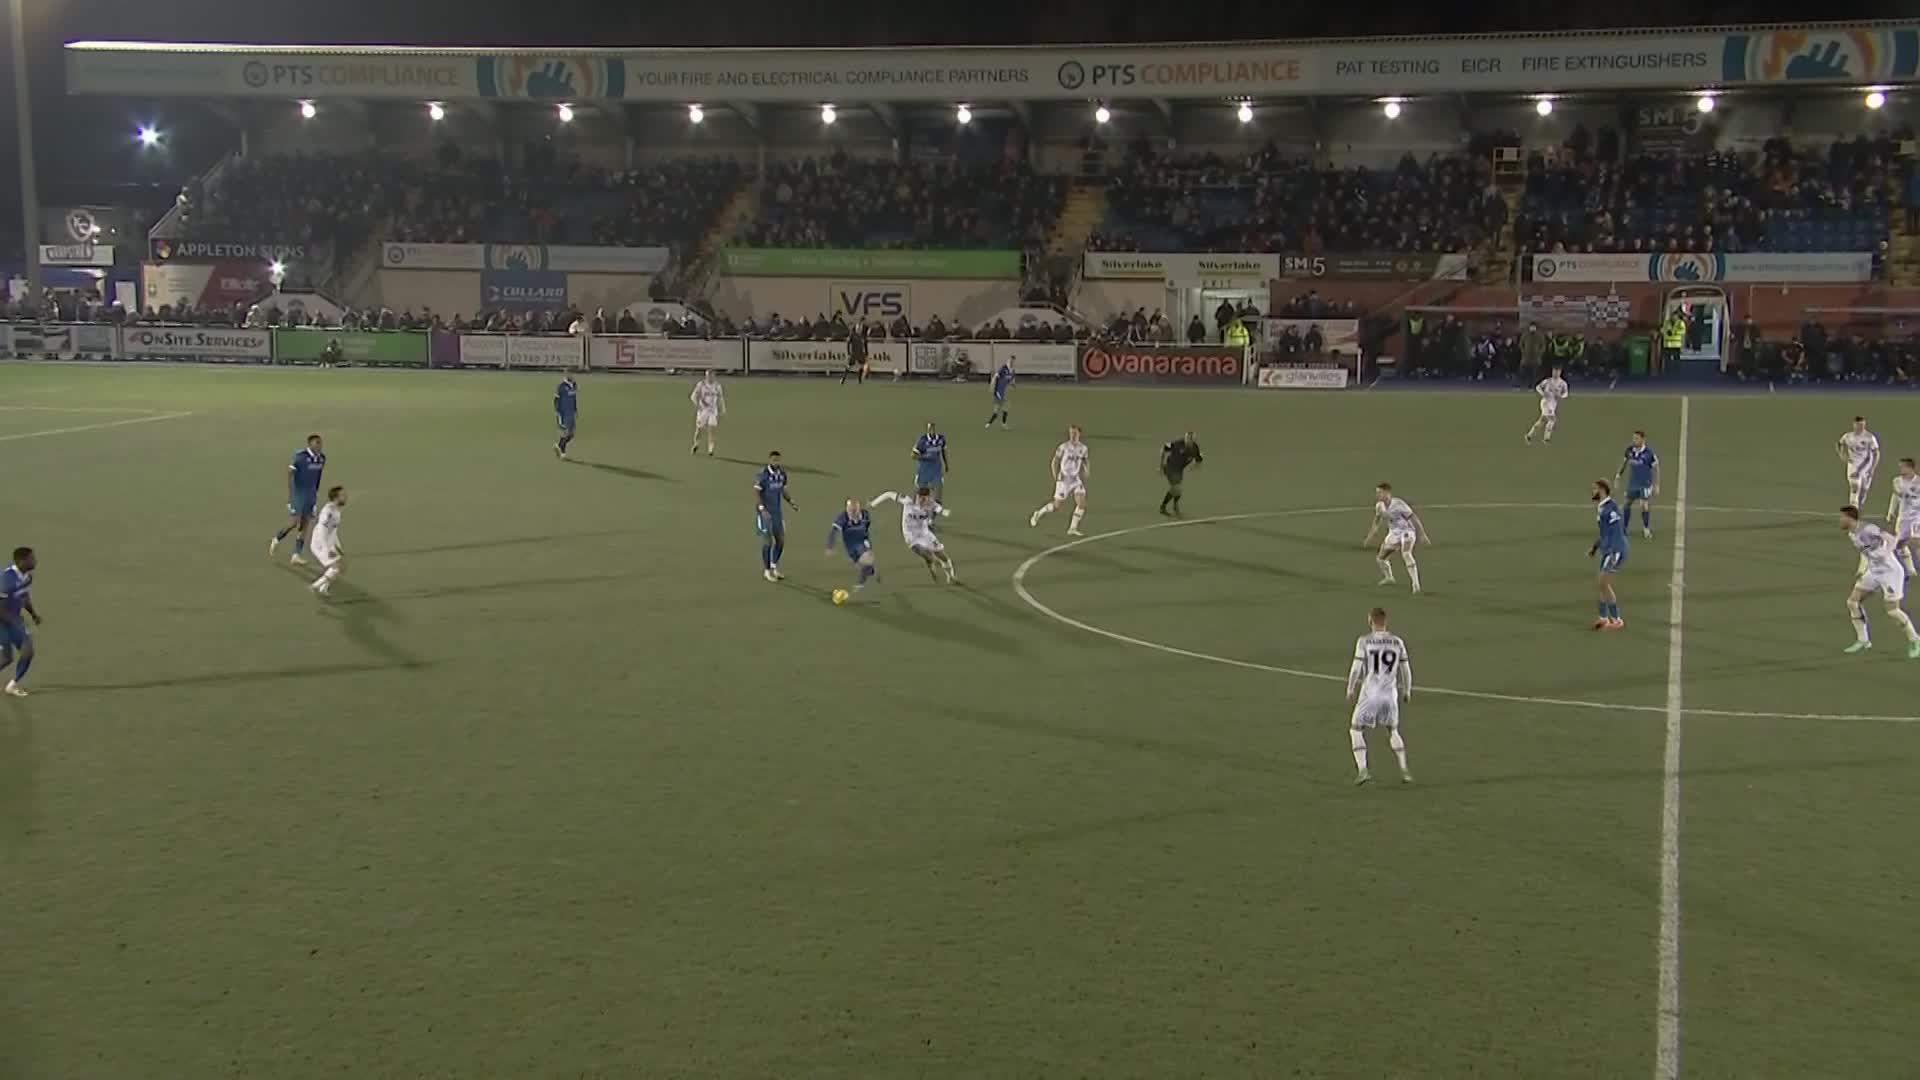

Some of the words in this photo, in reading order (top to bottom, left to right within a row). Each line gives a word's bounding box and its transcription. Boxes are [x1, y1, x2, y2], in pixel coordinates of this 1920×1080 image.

[1093, 64, 1135, 85] PTS
[1141, 60, 1300, 84] COMPLIANCE
[1336, 60, 1365, 75] PAT
[1371, 59, 1440, 74] TESTING
[1461, 58, 1501, 73] EICR
[1522, 56, 1560, 71] FIRE
[1565, 53, 1707, 71] EXTINGUISHERS
[273, 65, 313, 84] PTS
[319, 66, 459, 86] COMPLIANCE
[638, 72, 678, 86] YOUR
[681, 72, 713, 86] FIRE
[718, 72, 748, 86] AND
[751, 71, 842, 86] ELECTRICAL
[846, 70, 945, 85] COMPLIANCE
[949, 68, 1029, 83] PARTNERS
[176, 243, 256, 257] APPLETON
[260, 245, 304, 258] SIGNS
[840, 292, 902, 316] VFS
[1112, 354, 1238, 375] vanarama
[1369, 650, 1397, 674] 19
